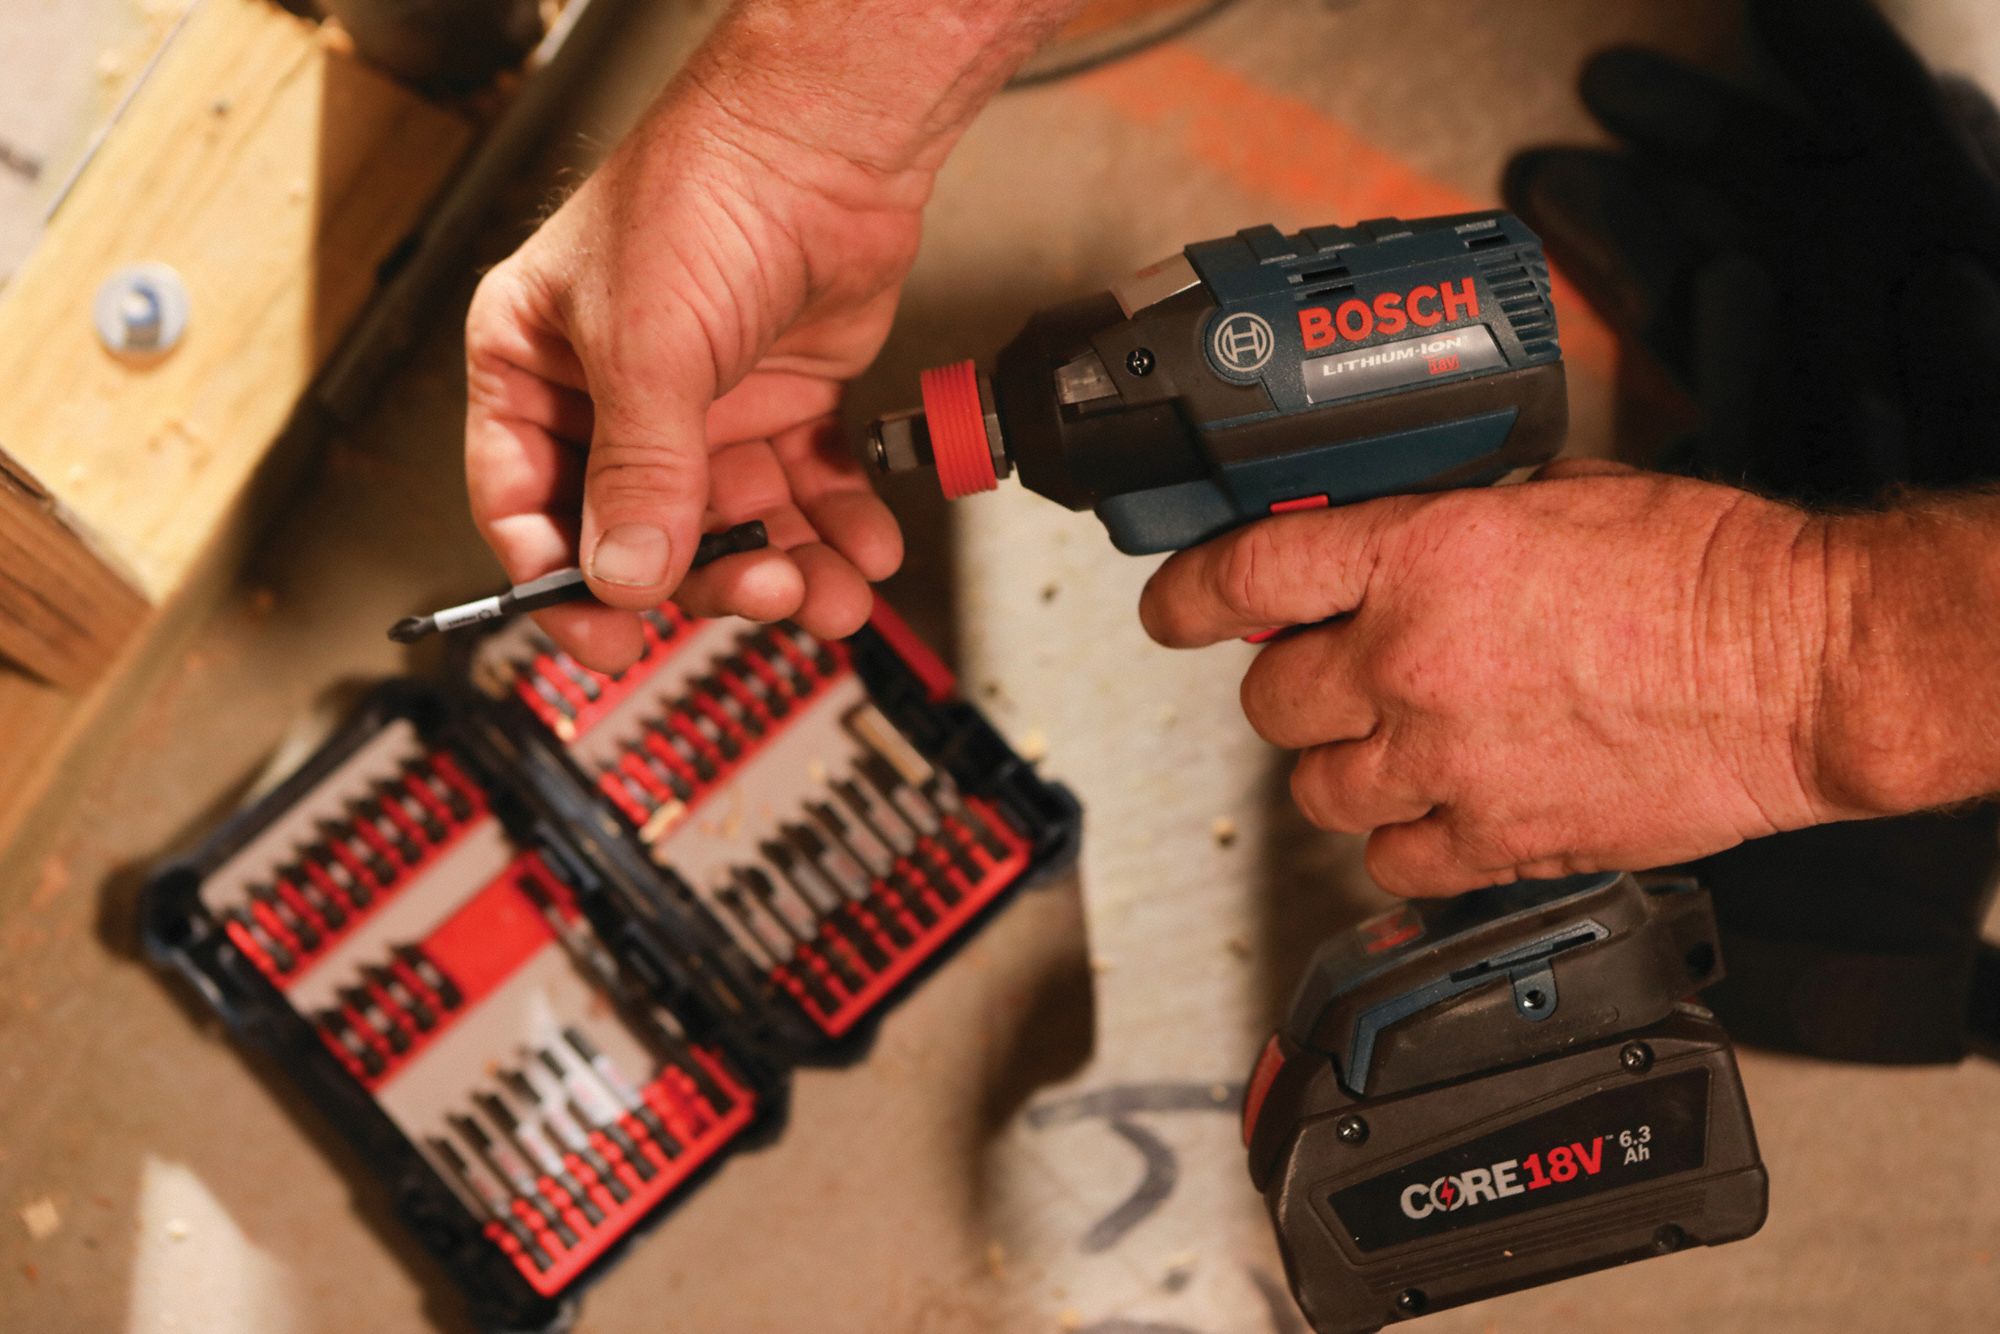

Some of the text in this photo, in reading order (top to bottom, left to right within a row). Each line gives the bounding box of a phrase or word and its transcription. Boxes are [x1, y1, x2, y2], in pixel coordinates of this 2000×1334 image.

[1298, 276, 1480, 350] BOSCH
[1323, 337, 1462, 376] LITHIUM-ION
[1429, 355, 1459, 374] 18V
[1619, 1125, 1651, 1148] 6.3
[1623, 1144, 1650, 1166] Ah
